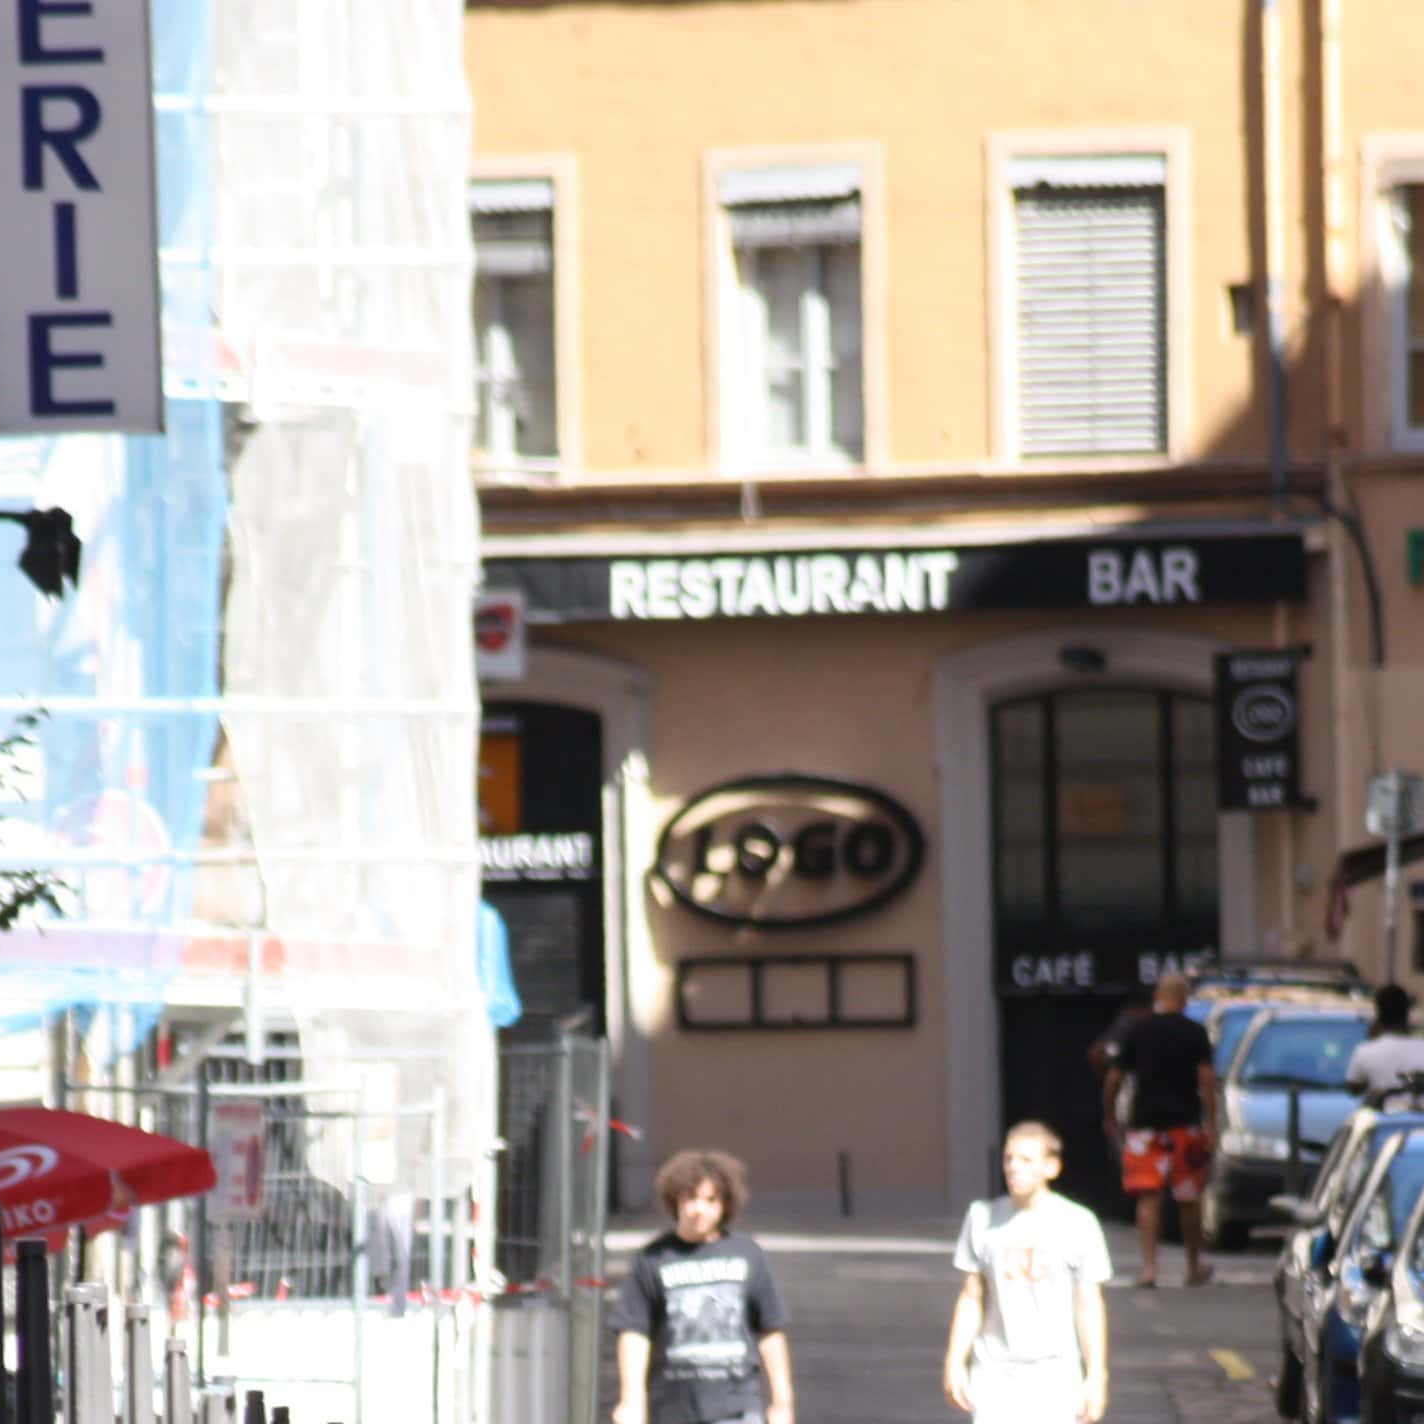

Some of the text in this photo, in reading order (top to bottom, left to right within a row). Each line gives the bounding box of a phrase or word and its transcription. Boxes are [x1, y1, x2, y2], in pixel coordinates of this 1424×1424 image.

[609, 548, 1201, 620] RESTAURANT BAR
[694, 820, 897, 880] LOGO
